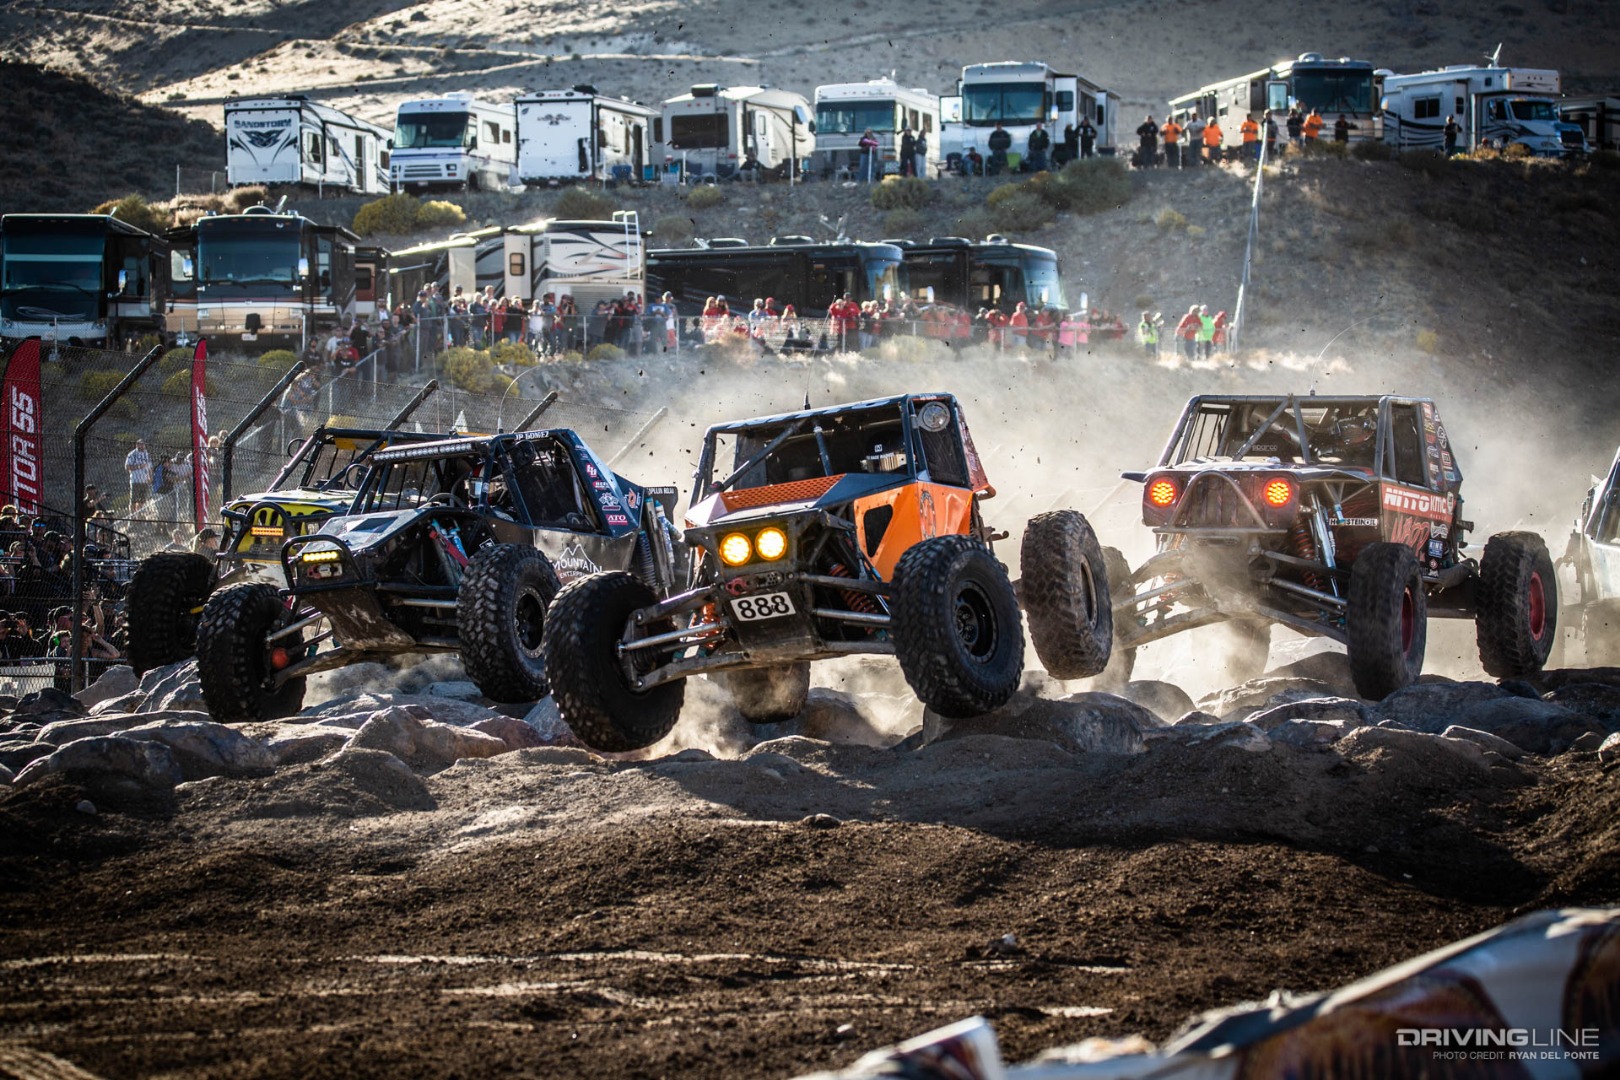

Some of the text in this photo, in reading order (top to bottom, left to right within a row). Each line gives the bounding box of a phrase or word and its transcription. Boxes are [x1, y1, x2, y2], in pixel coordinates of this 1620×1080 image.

[234, 118, 292, 129] SANDSTORM
[12, 385, 35, 434] 55
[1384, 487, 1430, 512] NITTO
[607, 514, 627, 522] ATO
[552, 557, 603, 573] MOUNTAIN
[737, 594, 790, 619] 888
